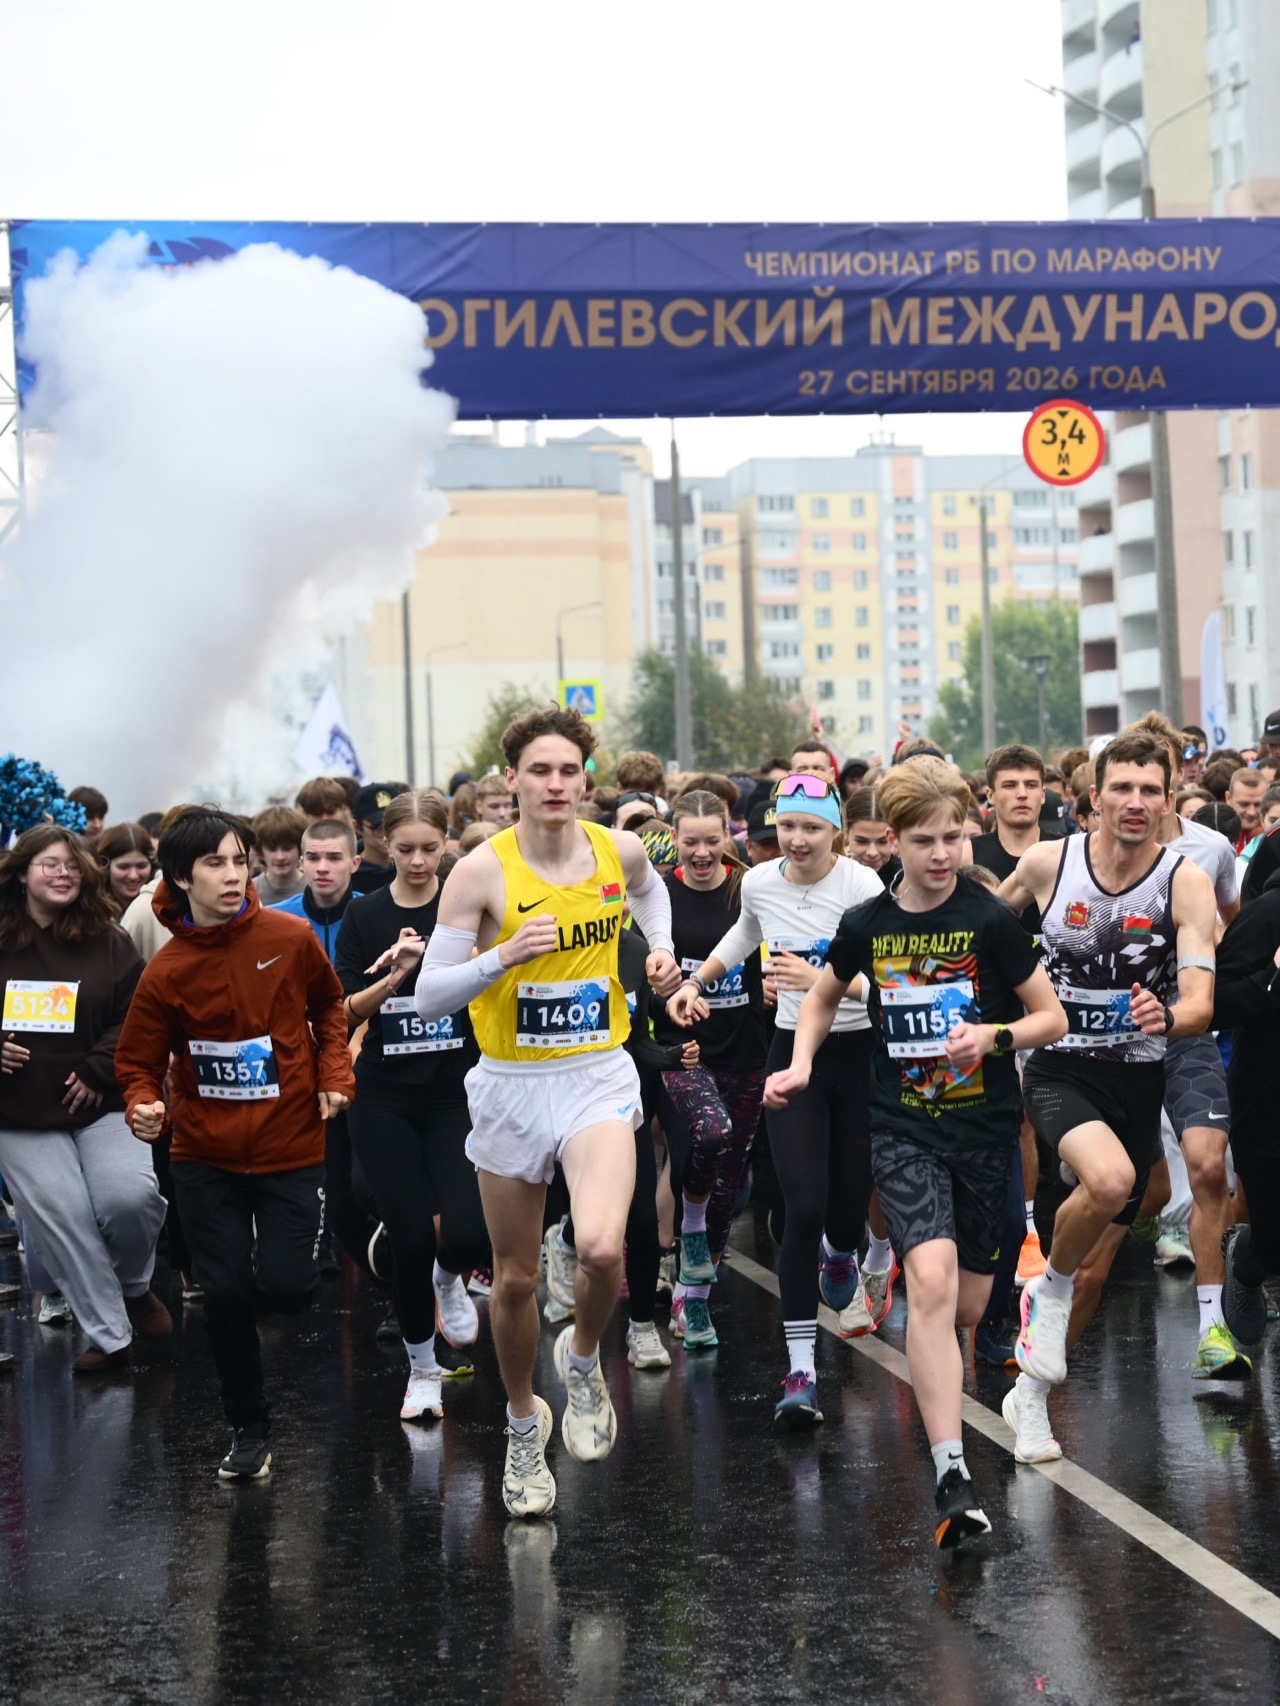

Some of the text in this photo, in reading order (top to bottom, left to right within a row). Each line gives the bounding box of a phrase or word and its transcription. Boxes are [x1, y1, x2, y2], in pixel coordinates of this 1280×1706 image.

[744, 246, 1222, 277] ЧЕМПИОНАТ РБ ПО МАРАФОНУ
[418, 286, 845, 348] ОГИЛЕВСКИЙ
[799, 365, 1167, 395] 27 СЕНТЯБРЯ 2026 ГОДА
[1041, 418, 1087, 451] 3,4
[553, 914, 619, 953] LARUS
[872, 931, 975, 957] NEW REALITY
[706, 974, 743, 994] 042
[12, 995, 69, 1017] 5124
[537, 1001, 601, 1028] 1409
[904, 1007, 964, 1034] 1155
[1078, 1010, 1133, 1030] 1276
[212, 1059, 265, 1082] 1357
